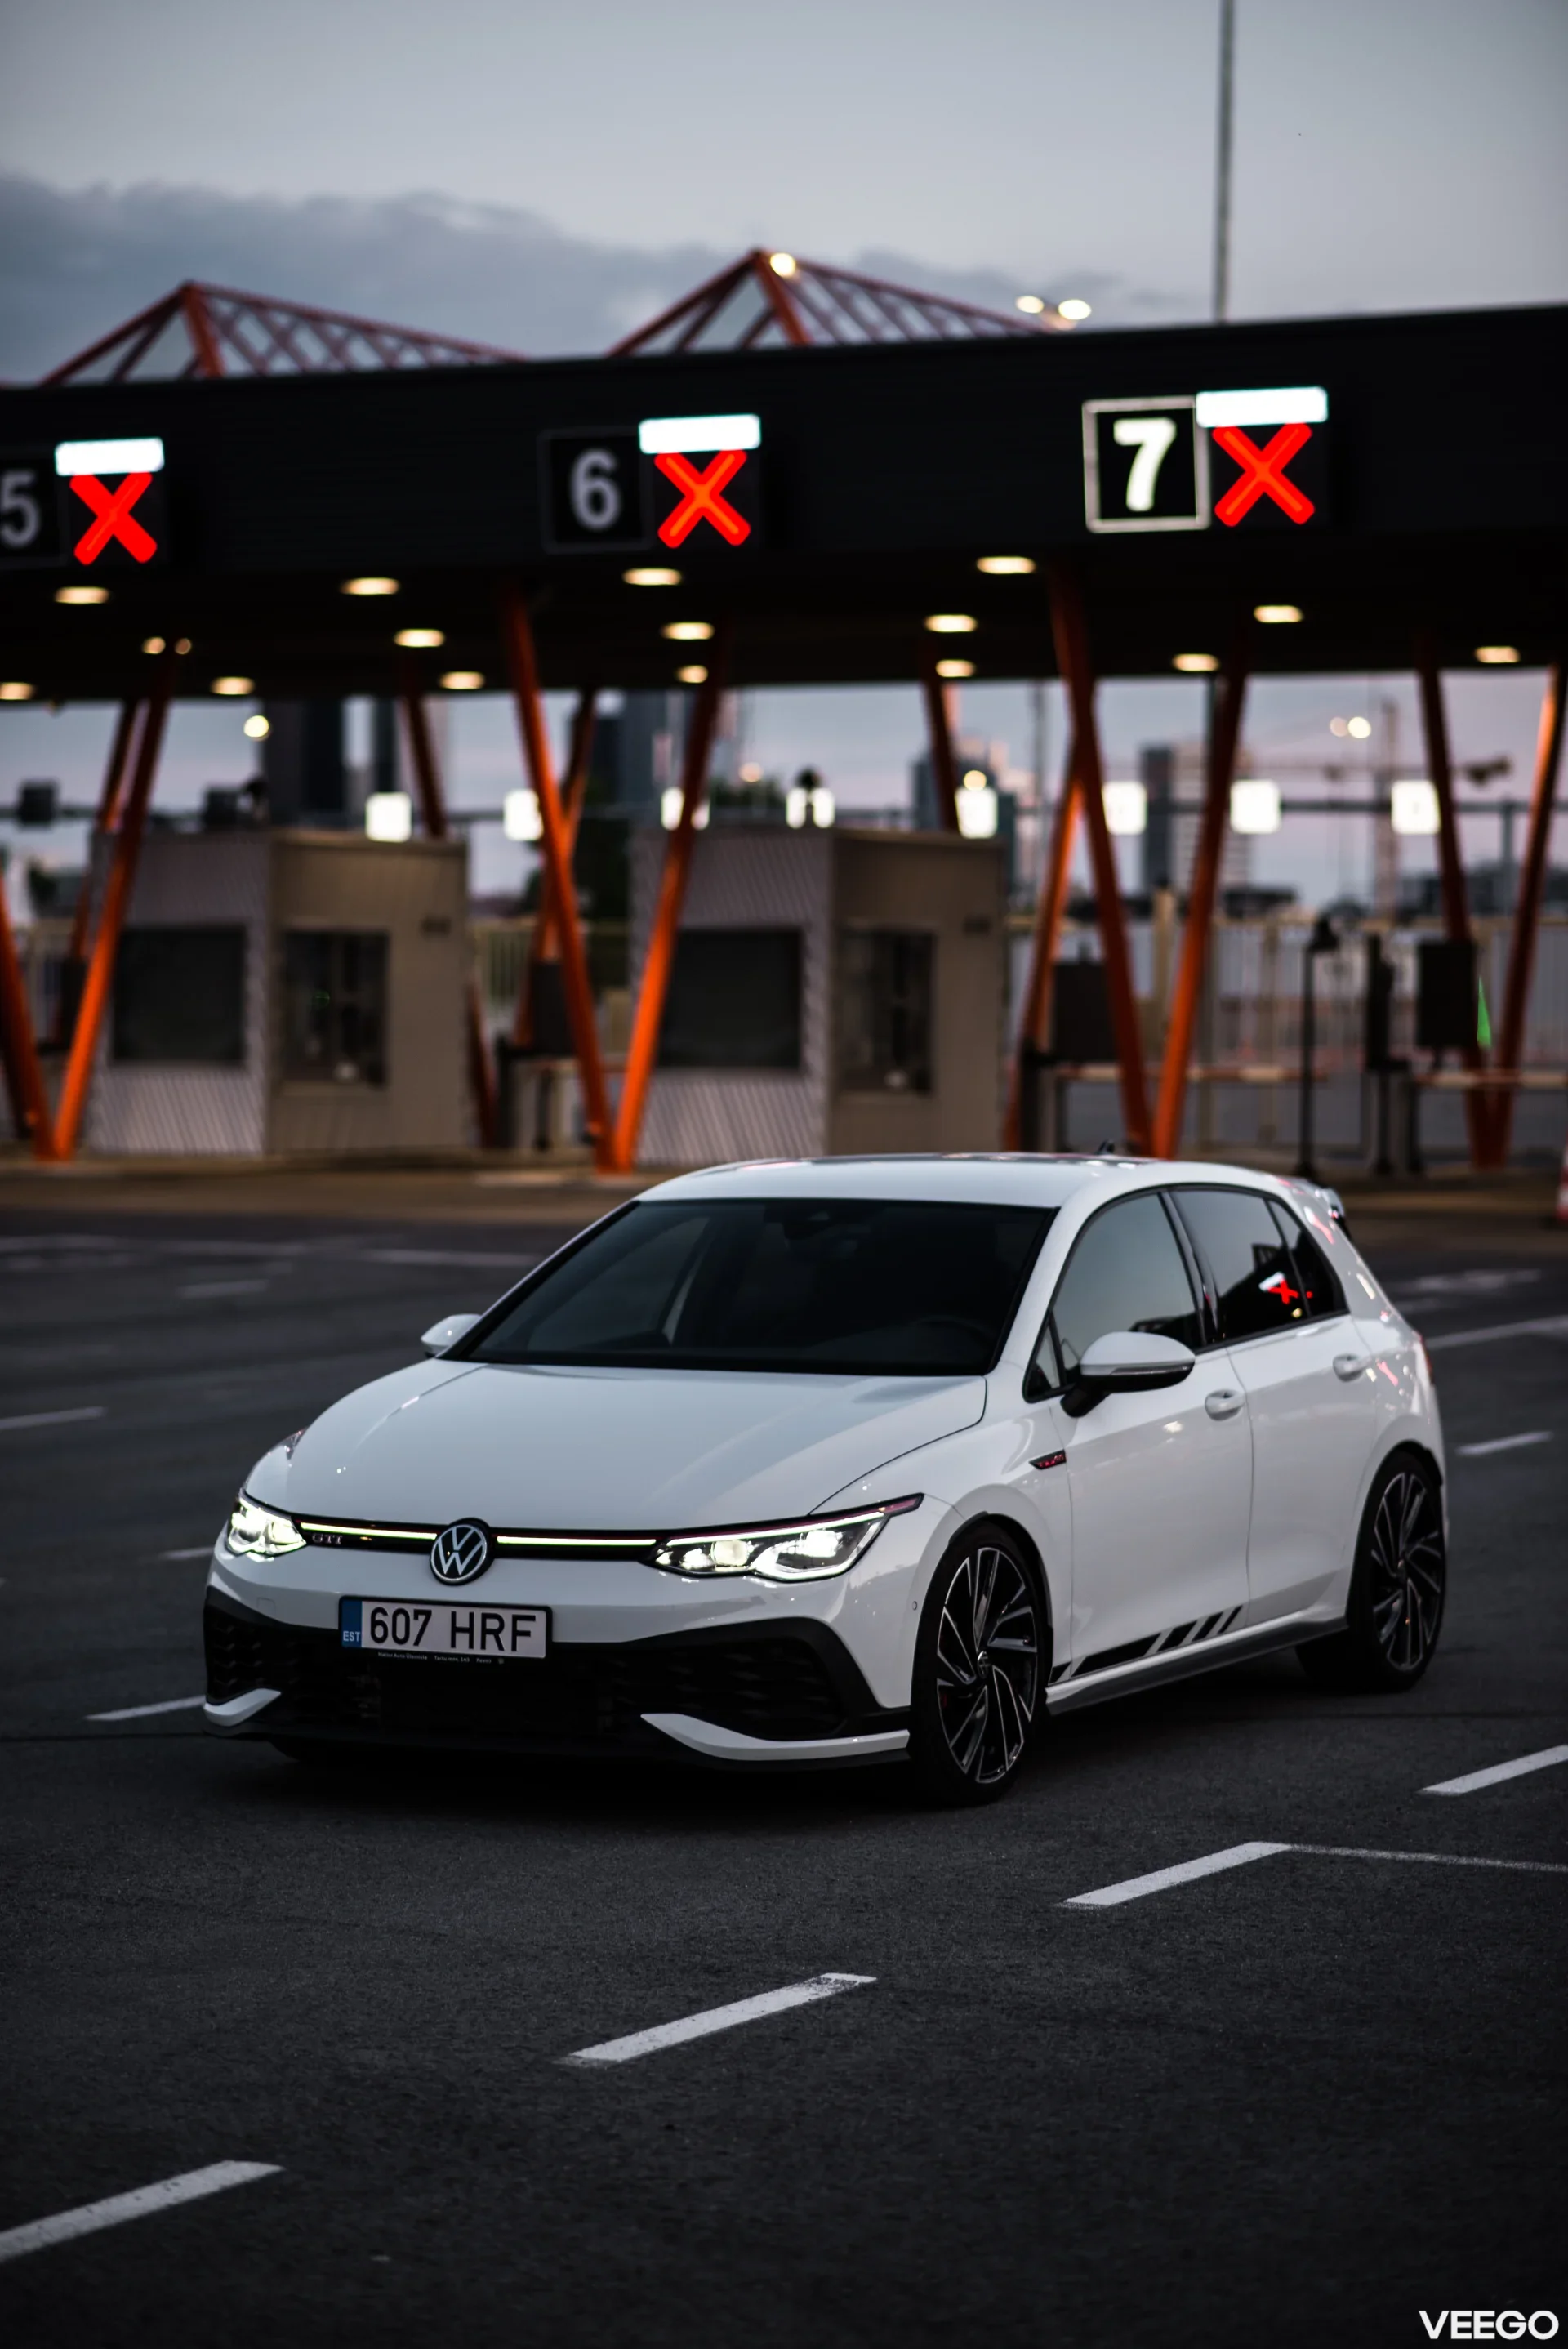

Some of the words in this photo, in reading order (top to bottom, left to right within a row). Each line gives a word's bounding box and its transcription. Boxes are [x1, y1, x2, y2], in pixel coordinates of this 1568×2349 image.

[569, 449, 622, 529] 6
[1112, 417, 1176, 512] 7
[0, 472, 40, 546] 5
[312, 1533, 342, 1544] GTI
[343, 1630, 361, 1642] EST
[370, 1607, 432, 1647] 607
[451, 1611, 536, 1652] HRF
